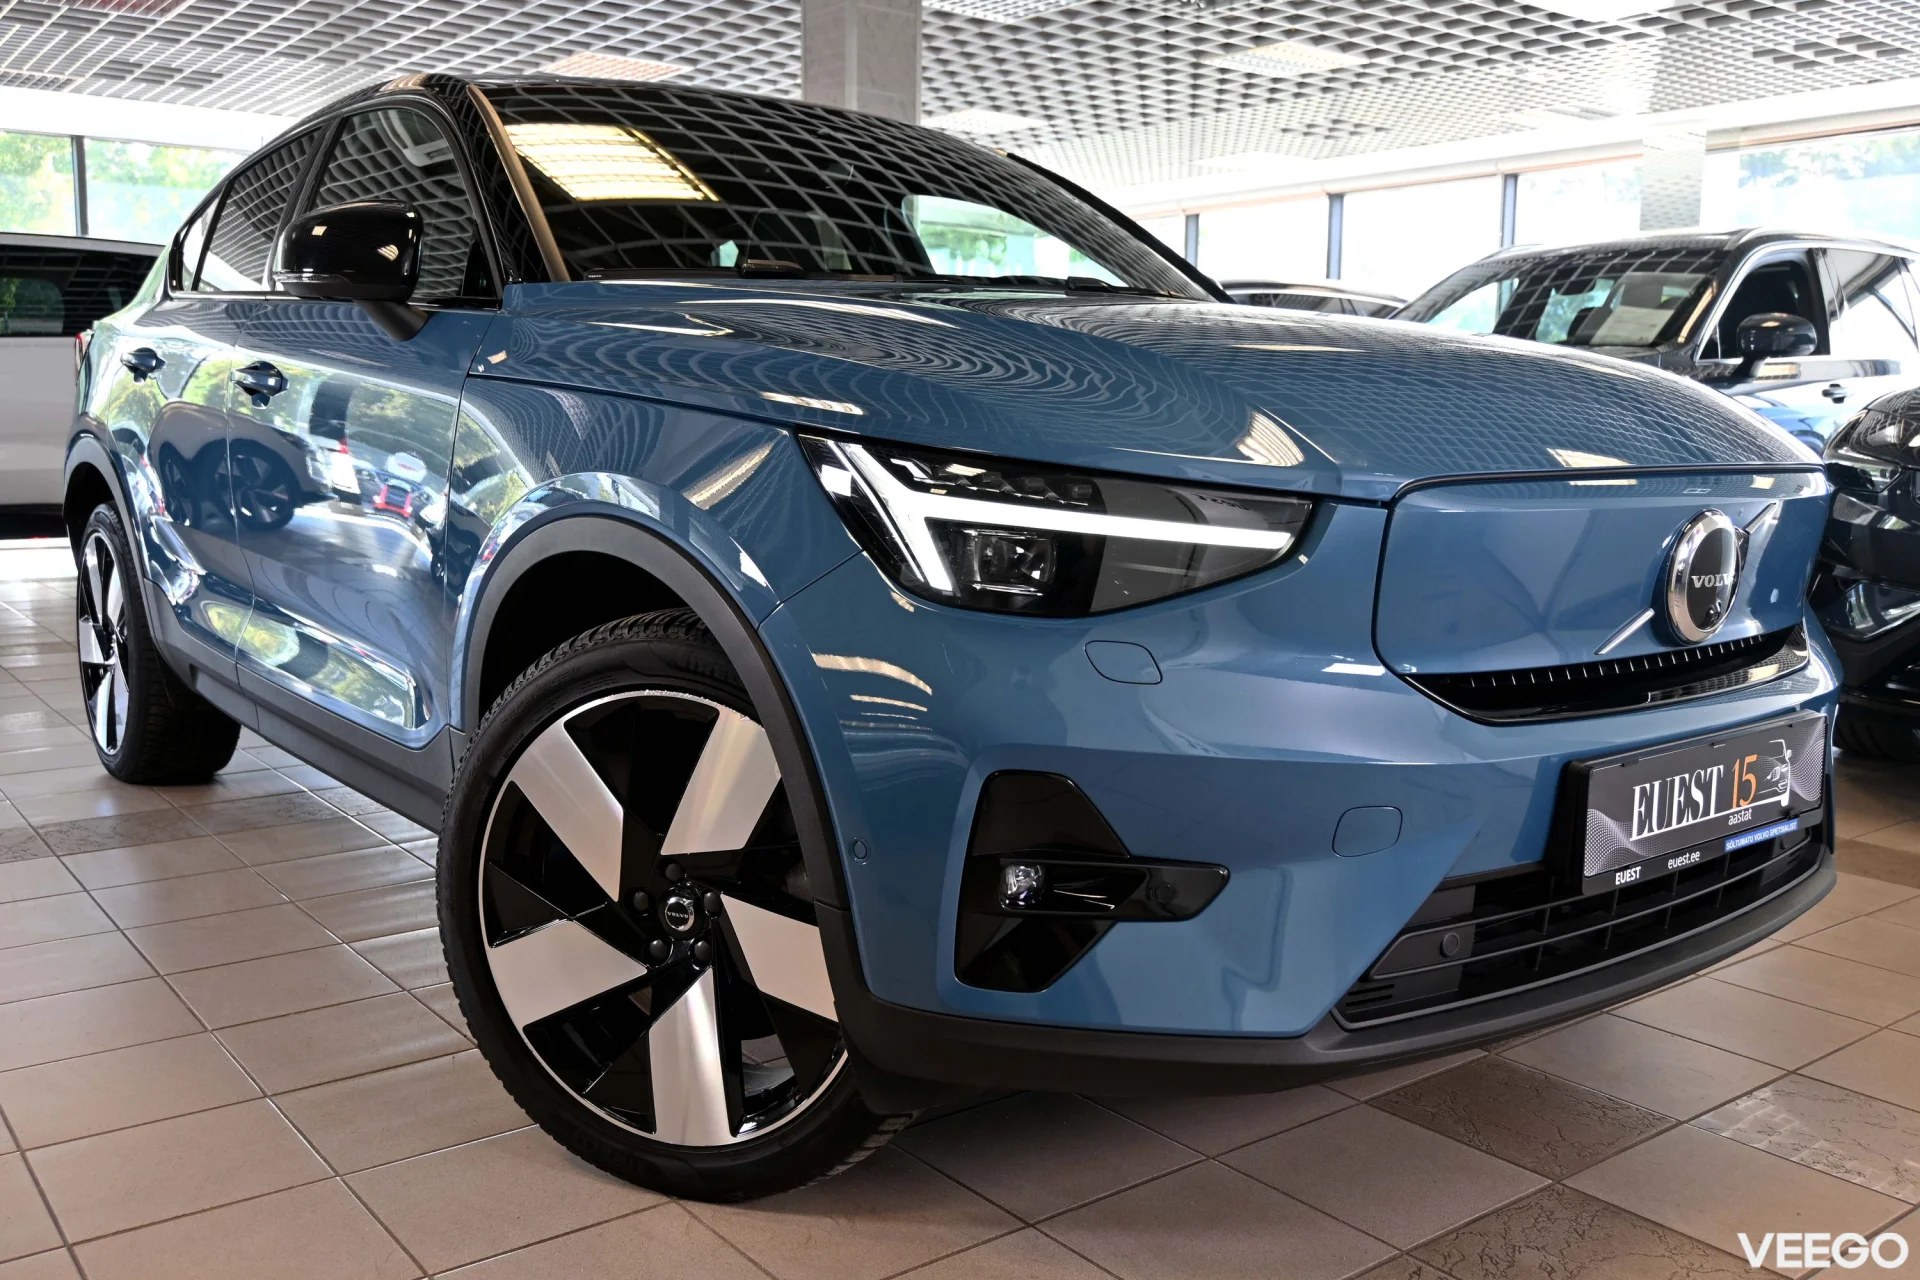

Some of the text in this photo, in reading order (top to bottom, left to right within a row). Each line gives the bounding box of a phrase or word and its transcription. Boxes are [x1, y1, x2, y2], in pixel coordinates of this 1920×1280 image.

[1691, 573, 1734, 589] VOLV
[1629, 754, 1758, 841] EUEST 15
[1728, 807, 1752, 826] aastat
[1754, 830, 1770, 842] VOLVO
[1667, 851, 1700, 870] euest.ee
[1615, 866, 1641, 886] EUEST
